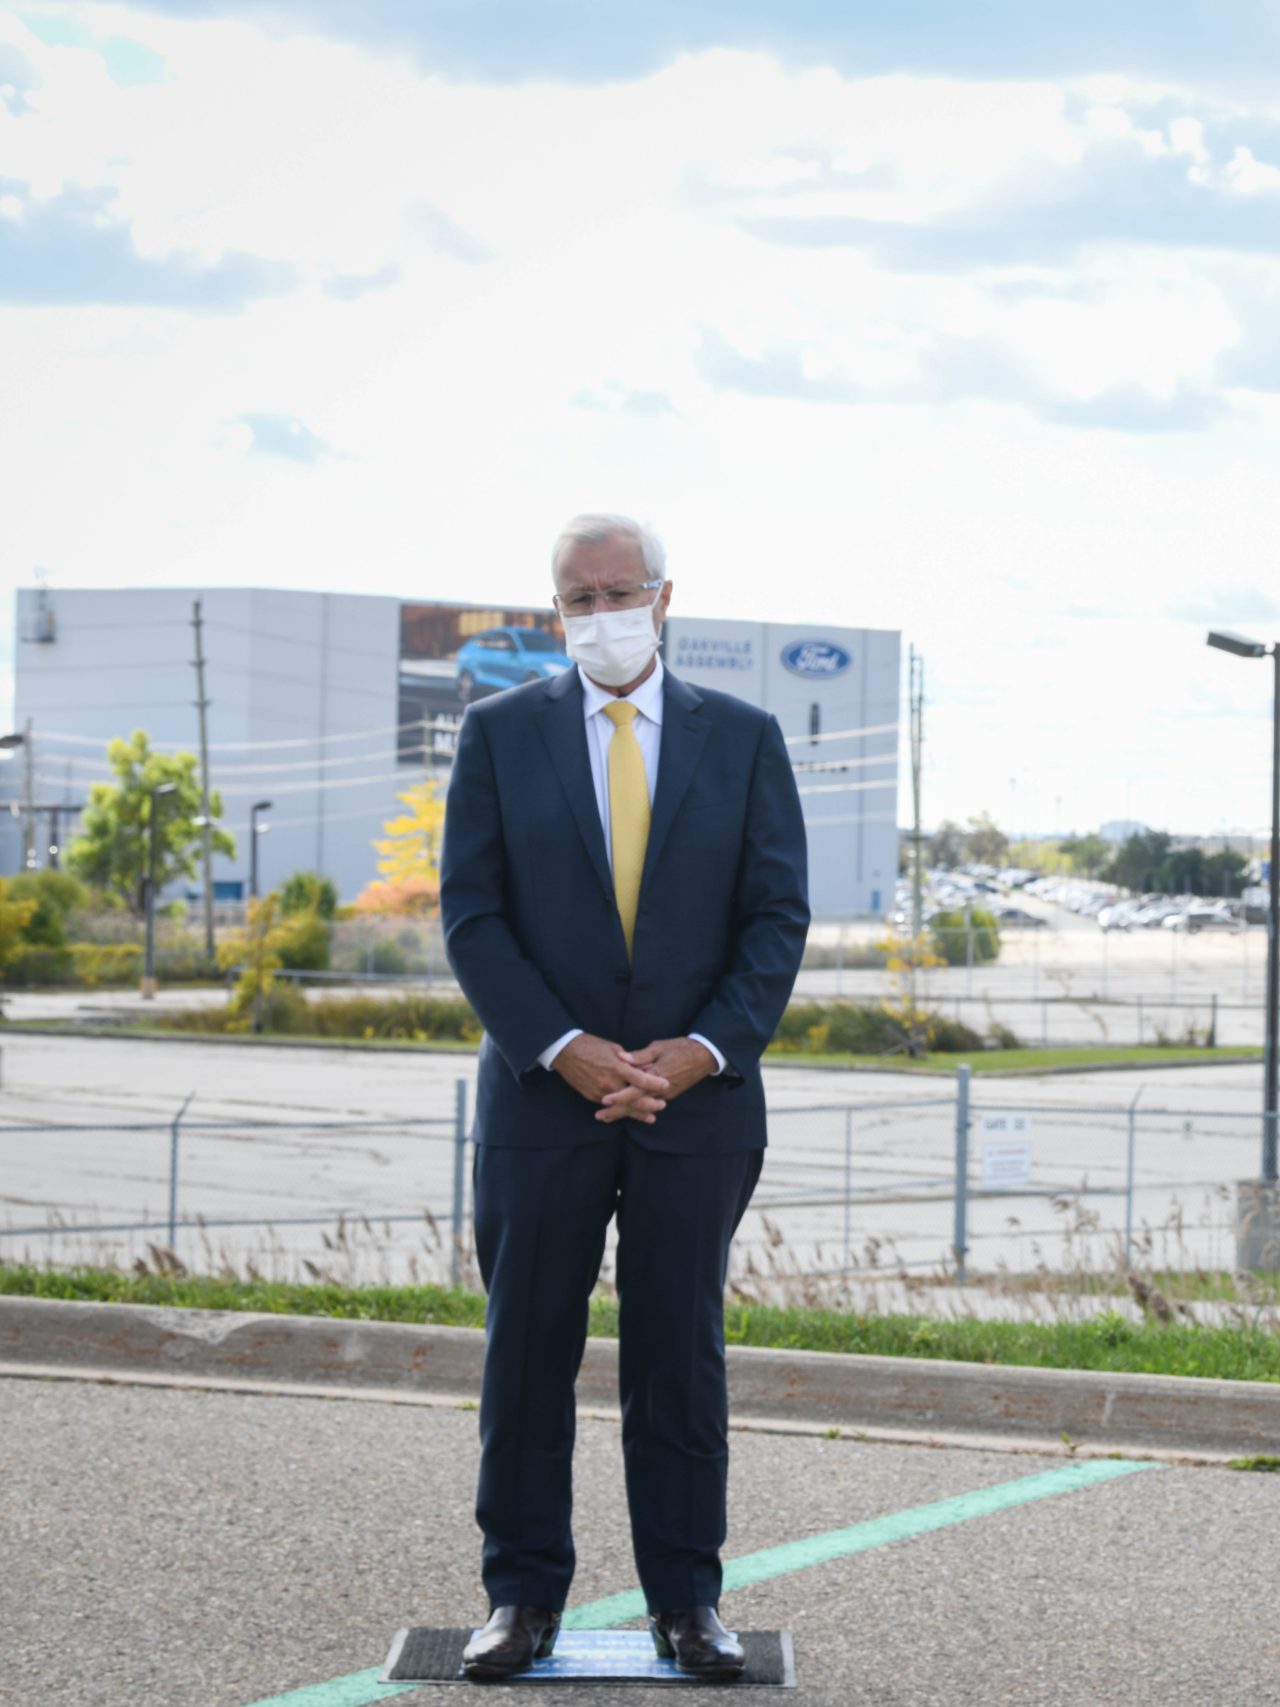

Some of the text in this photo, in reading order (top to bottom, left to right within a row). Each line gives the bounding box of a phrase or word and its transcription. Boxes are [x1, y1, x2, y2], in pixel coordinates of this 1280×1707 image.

[677, 637, 752, 654] OAKVILLE
[676, 655, 754, 671] ASSEMBLY
[795, 643, 842, 671] Ford
